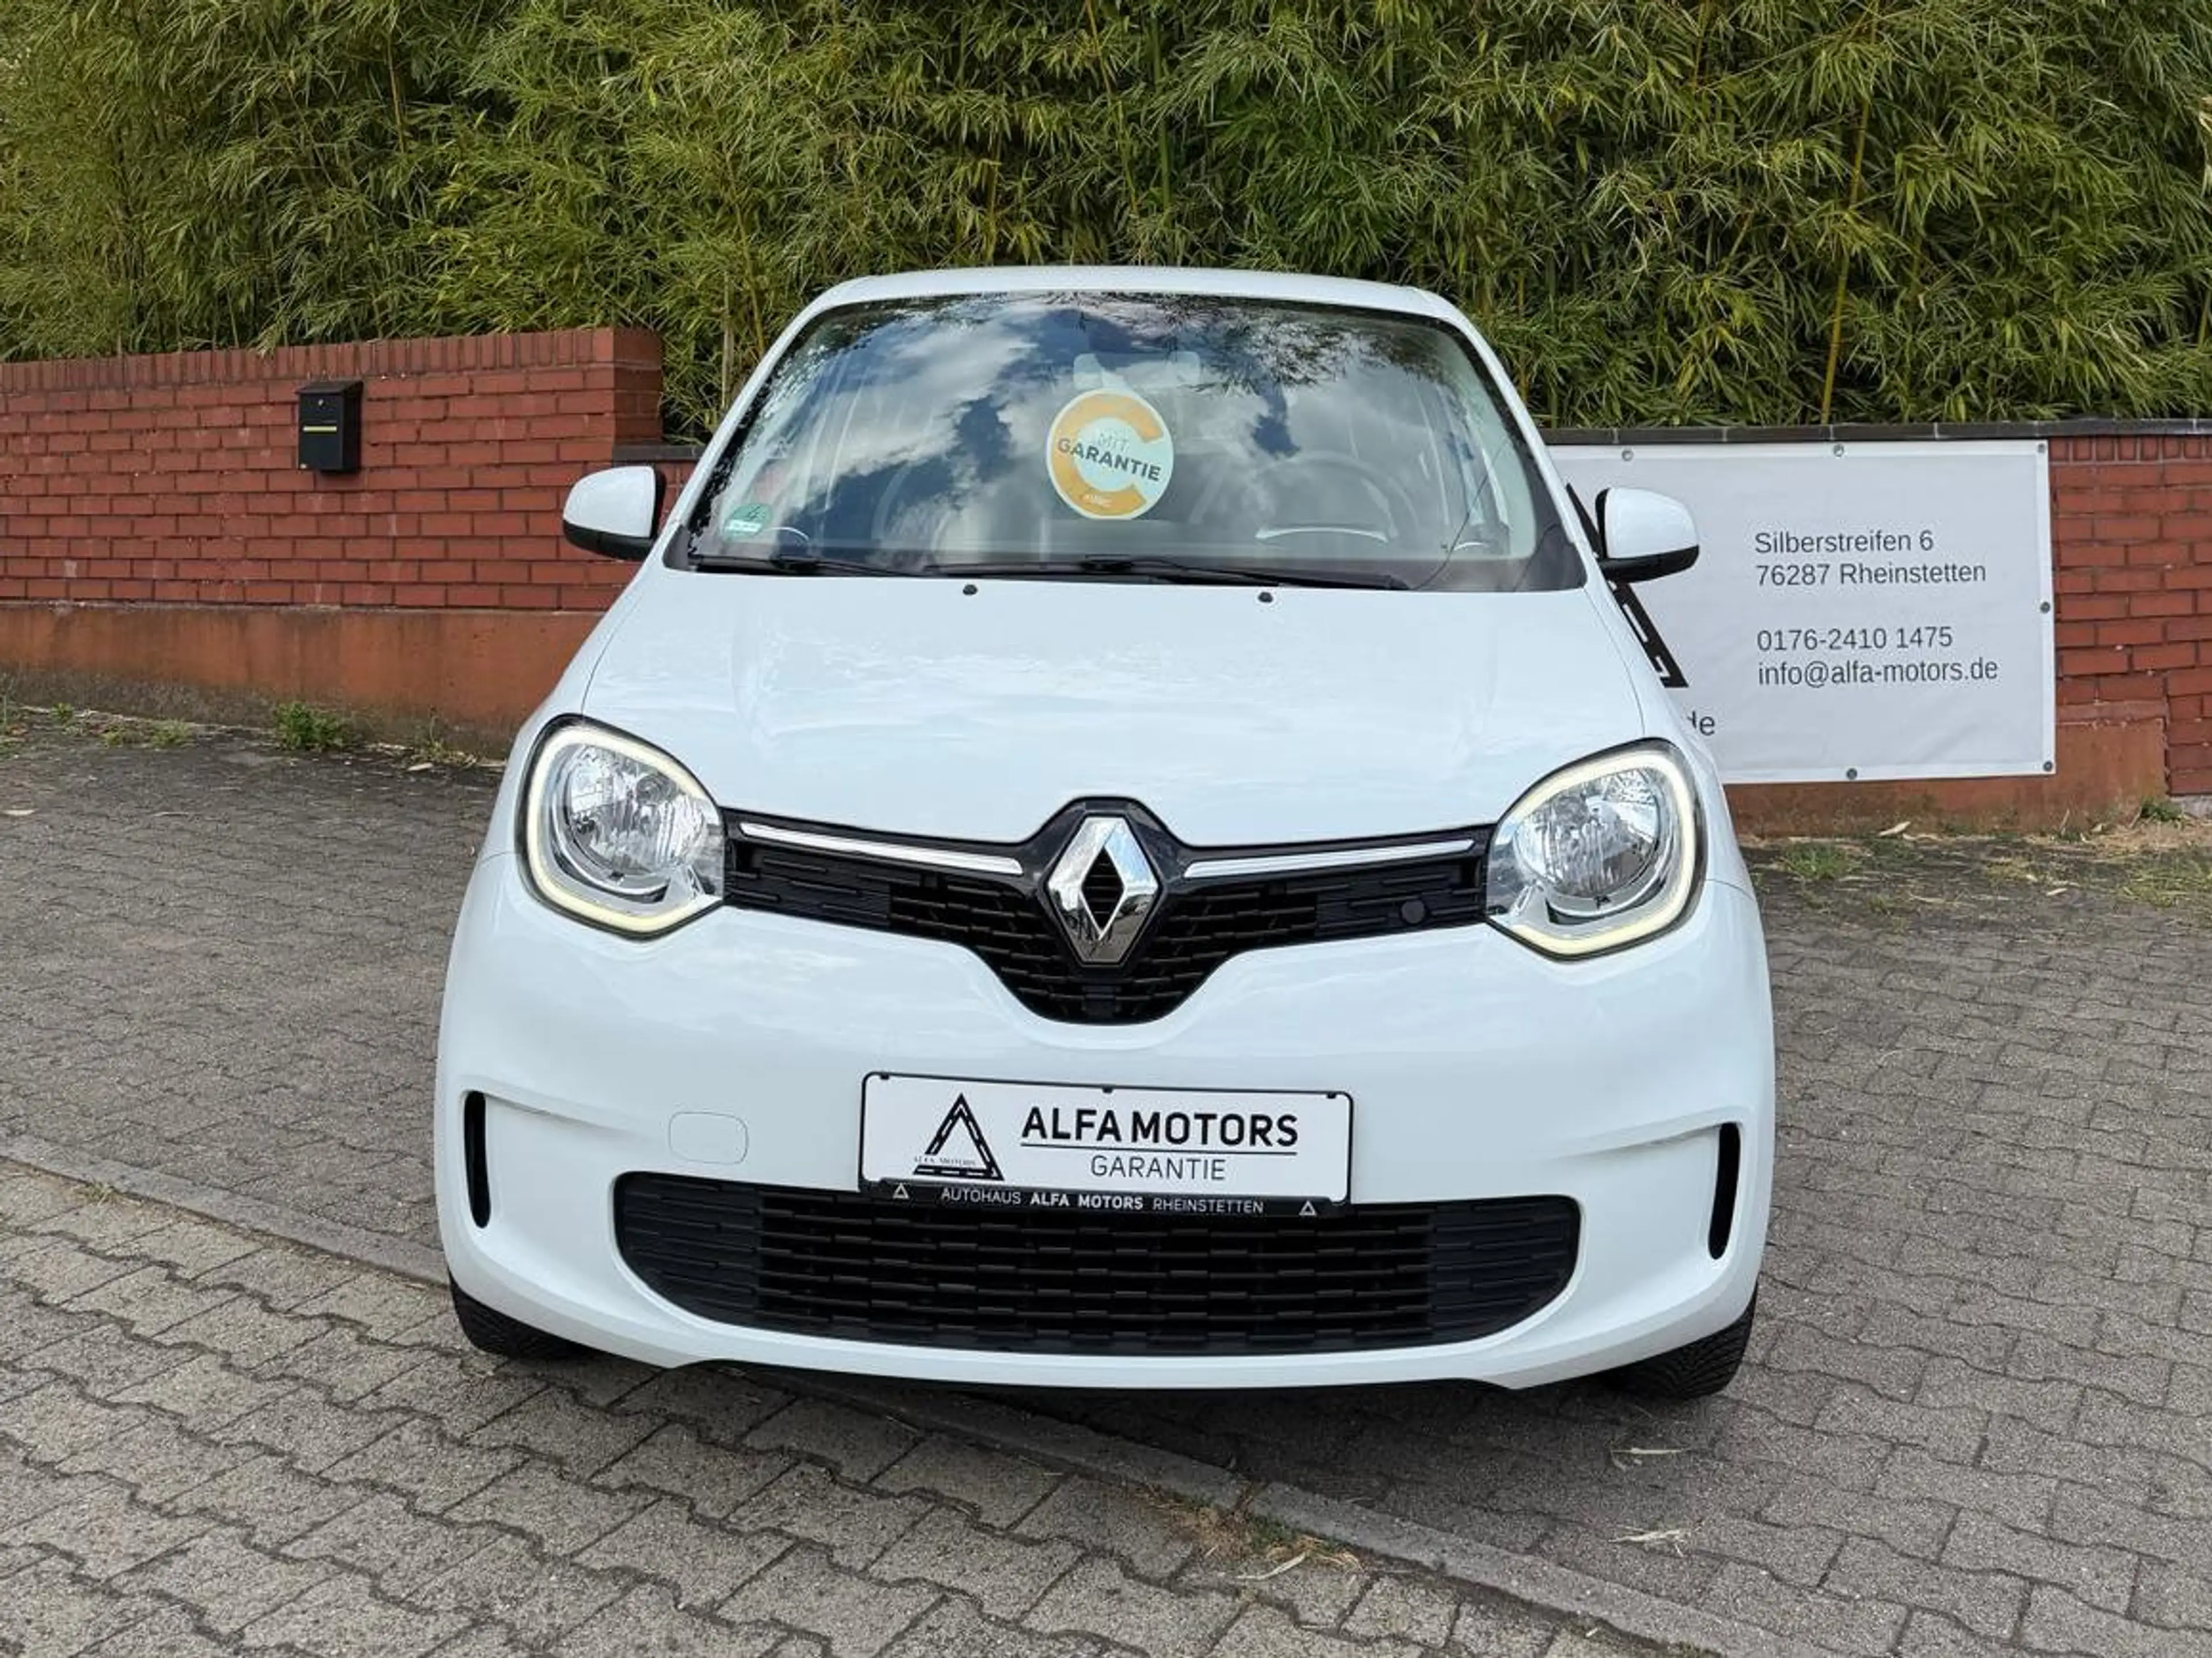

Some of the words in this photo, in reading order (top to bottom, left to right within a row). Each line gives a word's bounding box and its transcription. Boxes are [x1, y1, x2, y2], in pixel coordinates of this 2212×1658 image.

[1058, 438, 1161, 482] GARANTIE
[1755, 529, 1911, 554] Silberstreifen
[1920, 529, 1934, 551] 6
[1756, 563, 1831, 586] 76287
[1840, 562, 1986, 585] Rheinstetten
[1757, 627, 1887, 652] 0176-2410
[1896, 626, 1953, 649] 1475
[1759, 657, 1998, 687] info@alfa-motors.de
[1021, 1106, 1123, 1142] ALFA
[1131, 1111, 1298, 1147] MOTORS
[1090, 1156, 1226, 1181] GARANTIE
[941, 1187, 1022, 1205] AUTOHAUS
[1030, 1192, 1070, 1206] ALFA
[1078, 1194, 1143, 1210] MOTORS
[1153, 1197, 1264, 1214] RHEINSTETTEN
